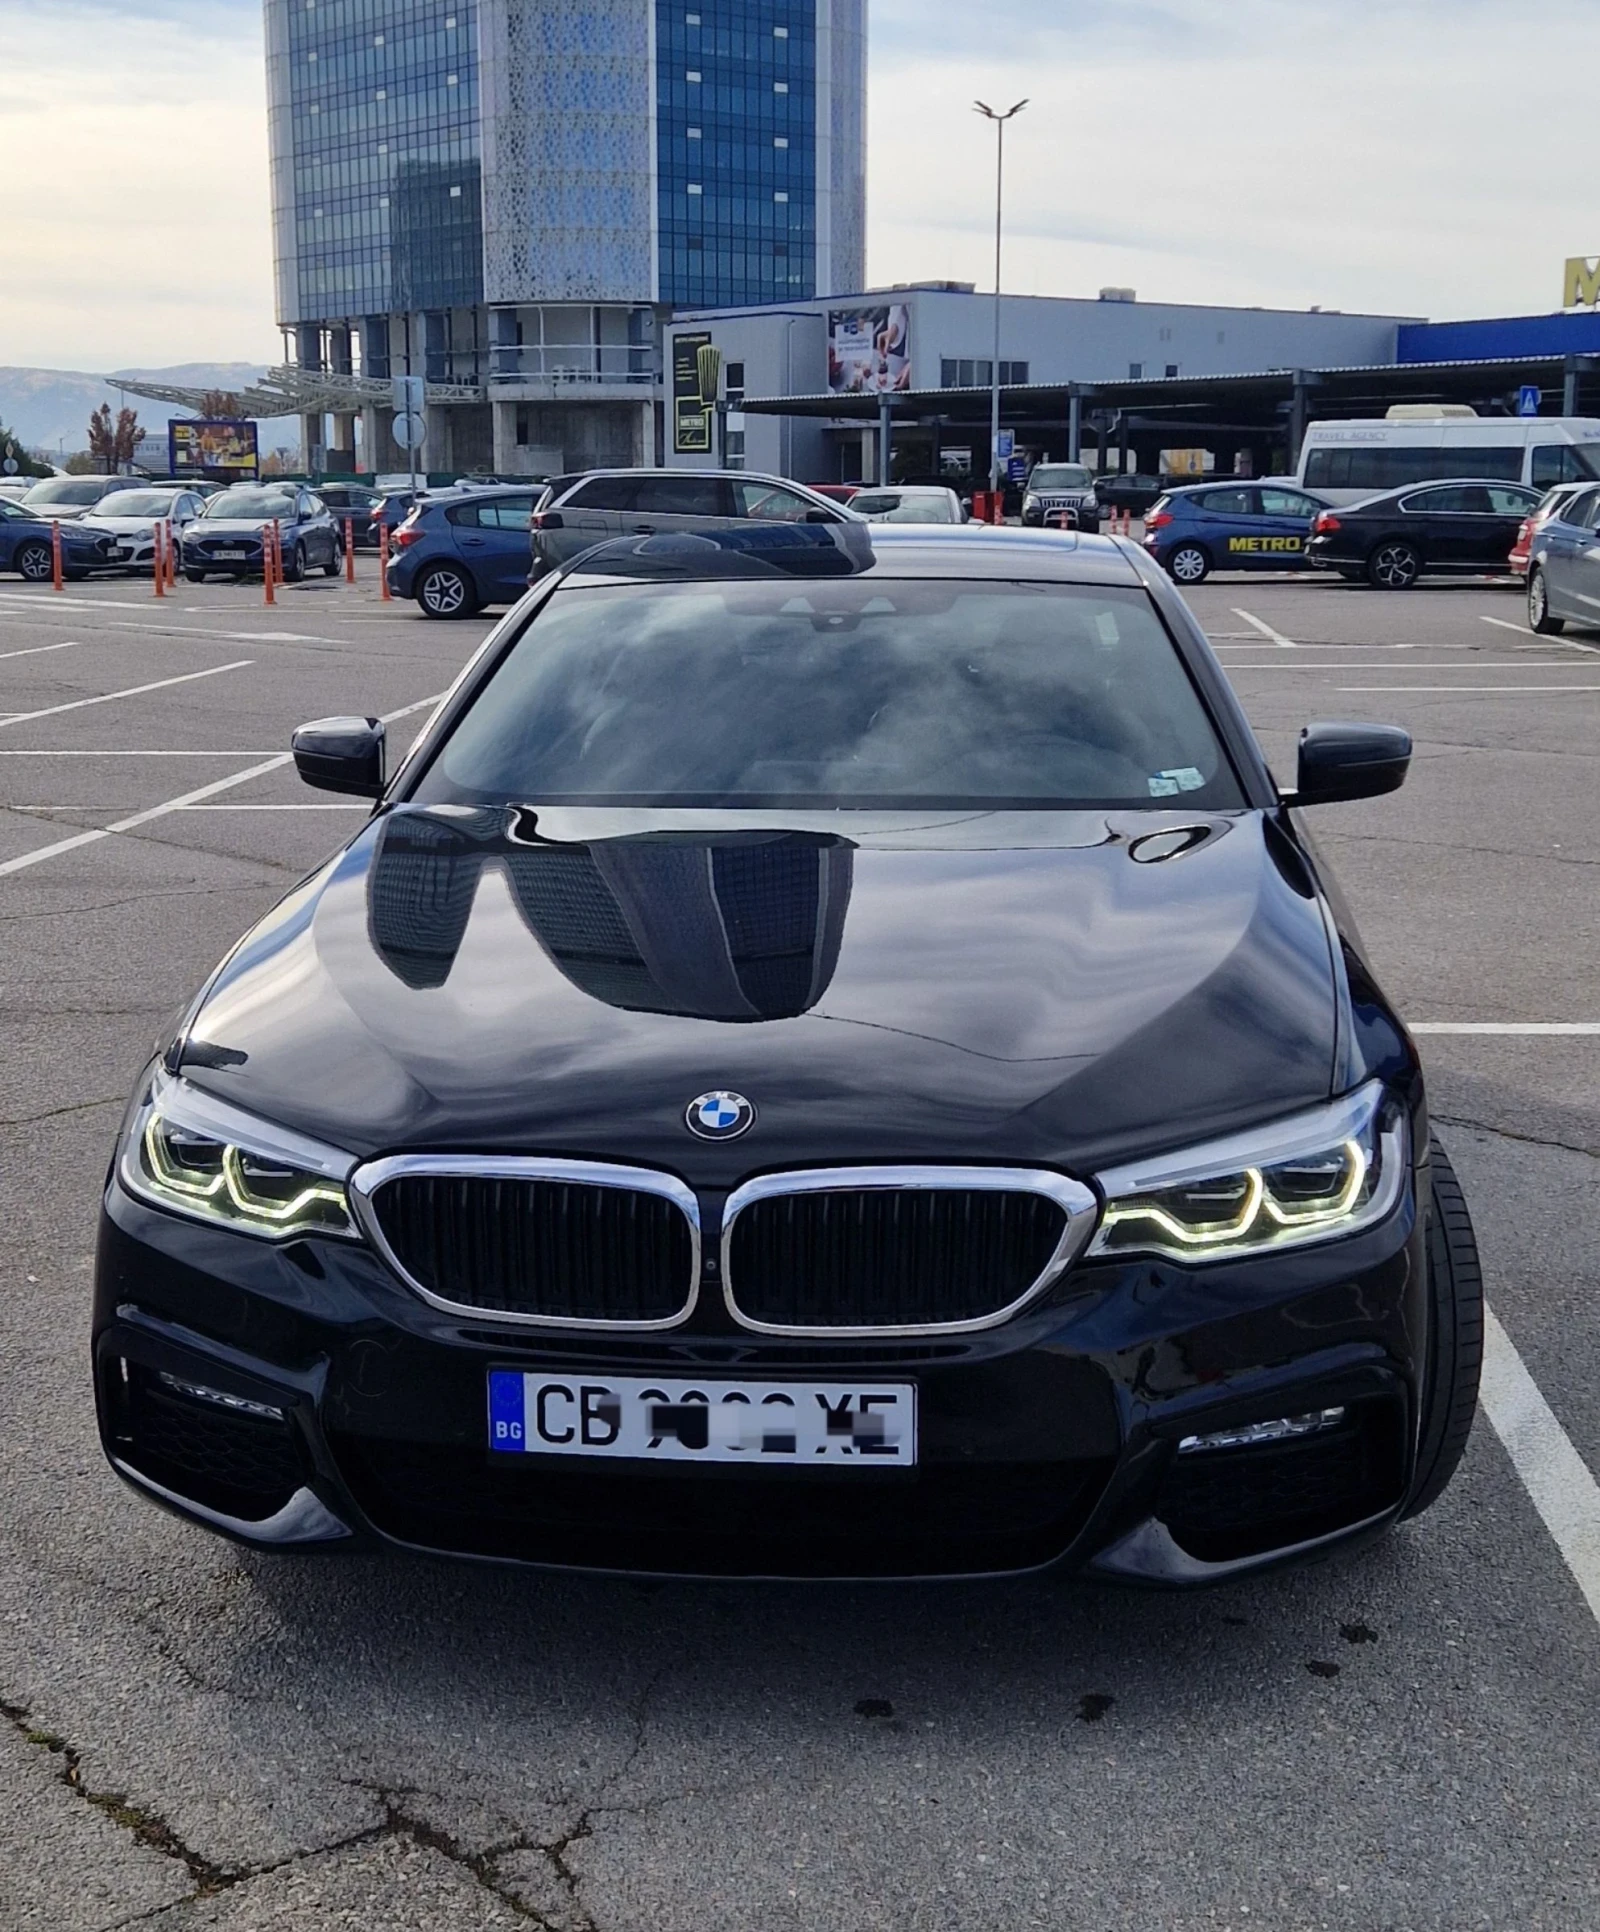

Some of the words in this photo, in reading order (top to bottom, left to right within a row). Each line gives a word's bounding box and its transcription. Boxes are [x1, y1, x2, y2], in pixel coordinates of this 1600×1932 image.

[1229, 536, 1301, 551] METRO
[692, 1091, 749, 1107] BMW
[496, 1421, 522, 1440] BG
